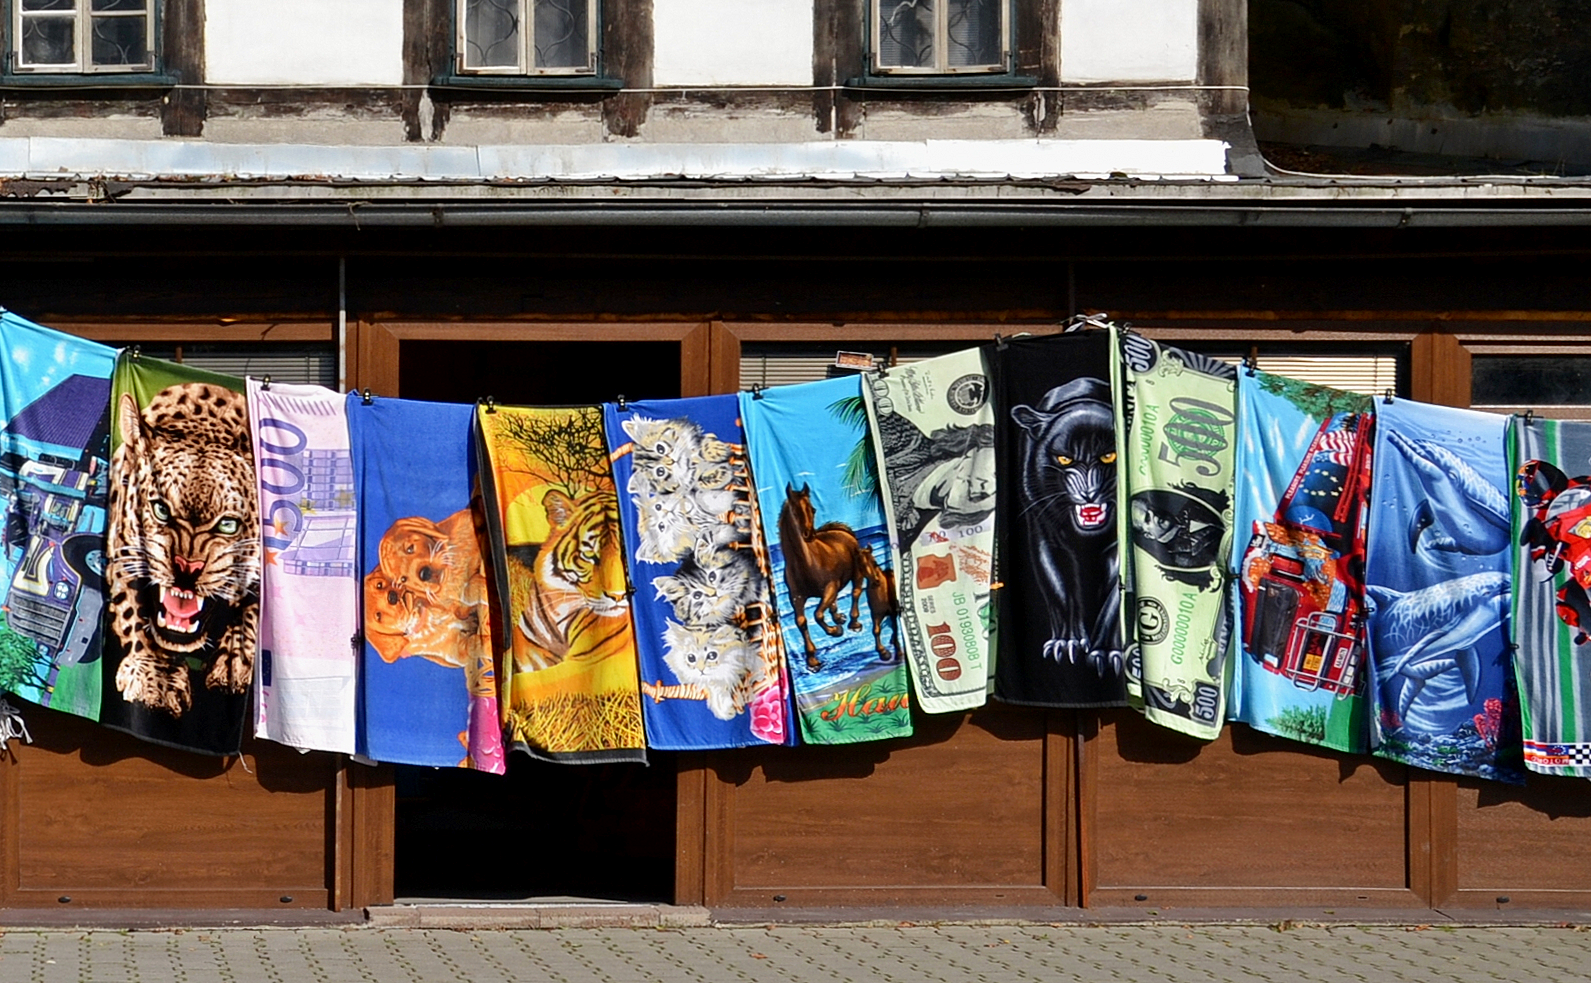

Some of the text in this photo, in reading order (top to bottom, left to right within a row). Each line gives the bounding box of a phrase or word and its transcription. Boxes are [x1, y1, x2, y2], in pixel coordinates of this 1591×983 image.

[1158, 397, 1235, 476] 500
[959, 525, 984, 538] 100
[926, 621, 962, 681] 100
[952, 591, 983, 670] JB 01930808 T
[1195, 686, 1218, 719] 500
